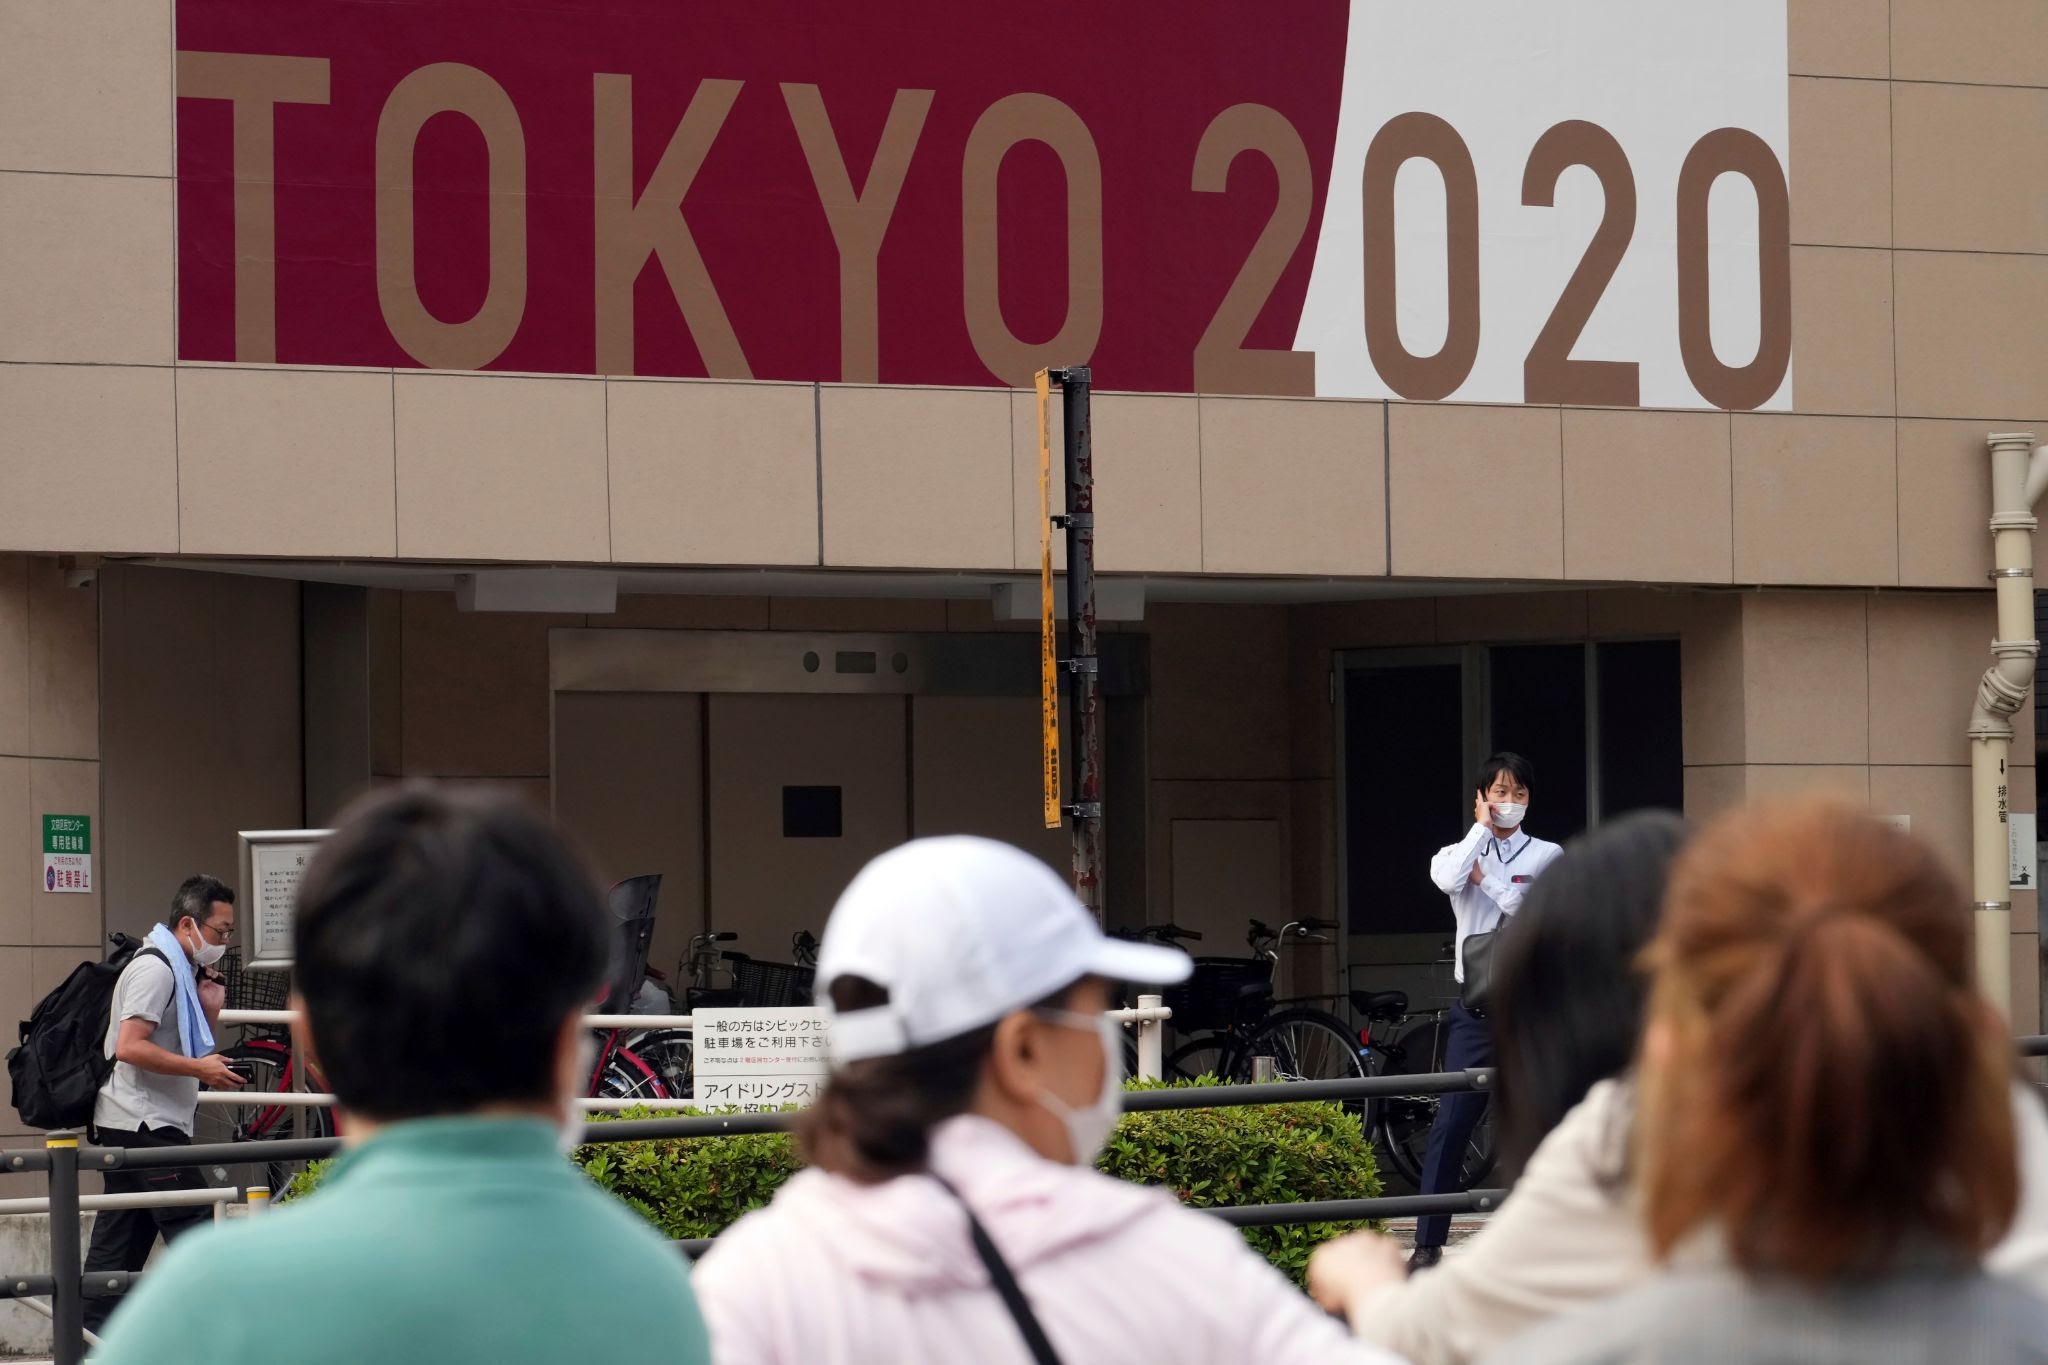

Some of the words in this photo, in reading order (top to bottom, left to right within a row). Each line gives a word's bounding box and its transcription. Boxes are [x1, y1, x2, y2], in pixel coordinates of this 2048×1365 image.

[177, 50, 1103, 388] TOKYO
[1191, 103, 1791, 410] 2020
[1998, 785, 2007, 823] 排水管
[57, 869, 89, 888] 駐輪禁止
